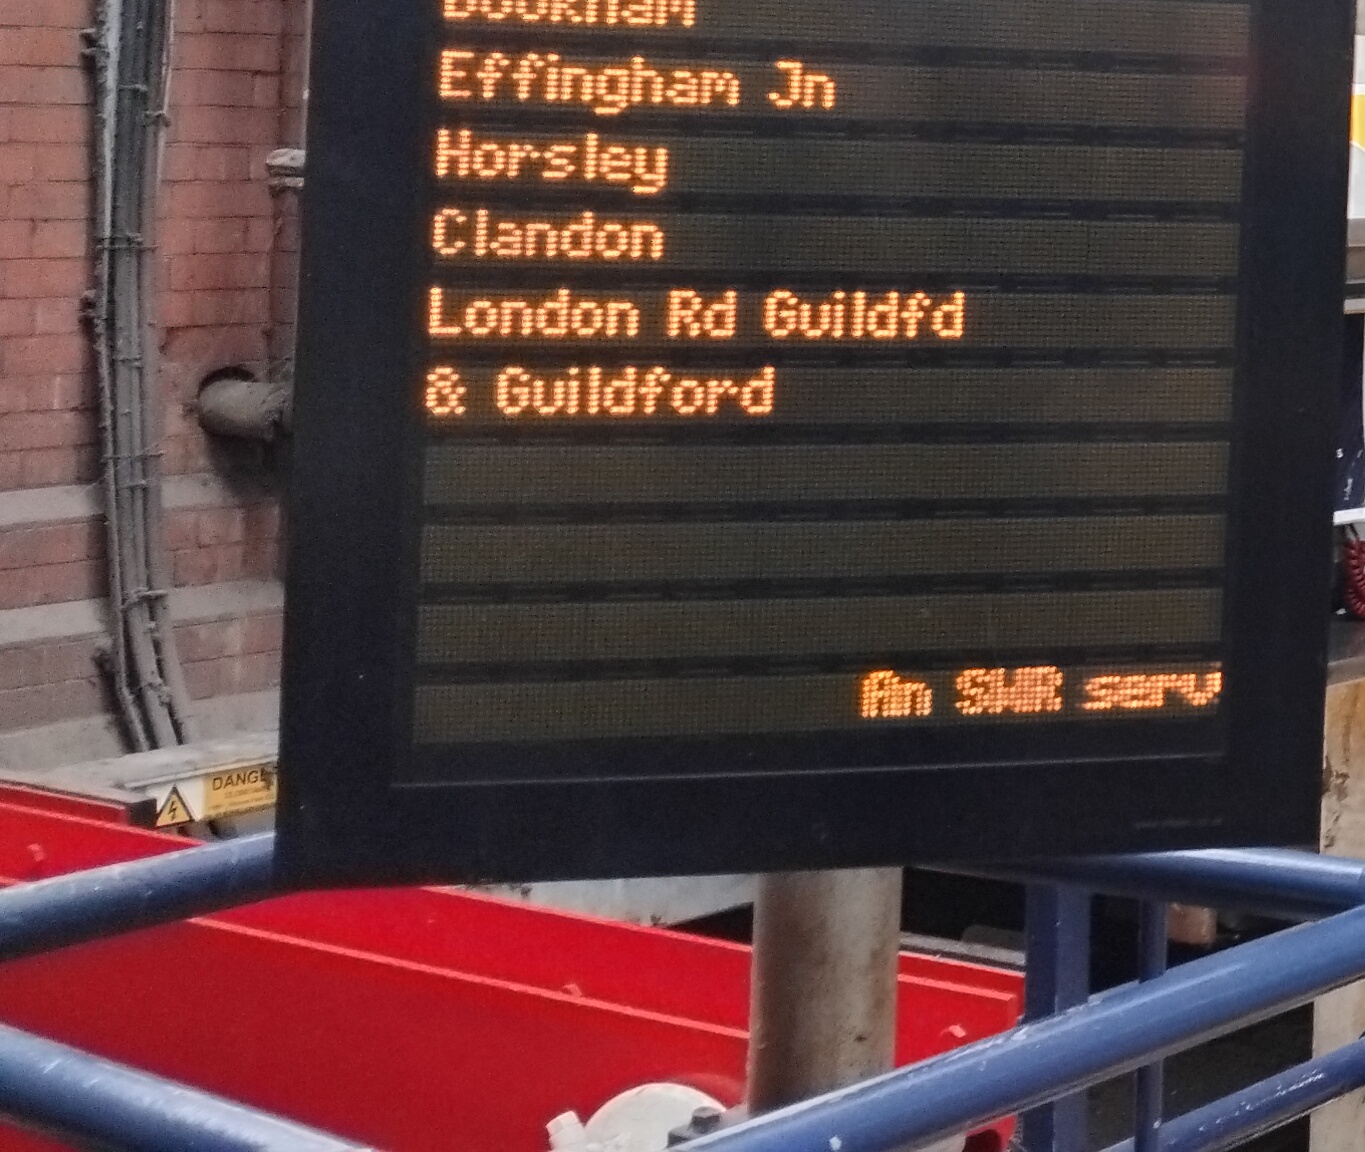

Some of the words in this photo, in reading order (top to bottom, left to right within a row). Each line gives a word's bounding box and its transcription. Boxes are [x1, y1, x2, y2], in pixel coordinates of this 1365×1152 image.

[438, 48, 741, 116] Effingham
[766, 60, 837, 110] Jn
[435, 127, 669, 195] Horsley
[432, 207, 665, 261] Clandon
[427, 286, 640, 338] London
[666, 289, 738, 339] Rd
[762, 289, 966, 340] Guildfd
[424, 366, 467, 416] &
[494, 365, 776, 417] Guildford
[860, 670, 933, 718] An
[955, 665, 1063, 715] SWR
[1081, 671, 1222, 711] serv
